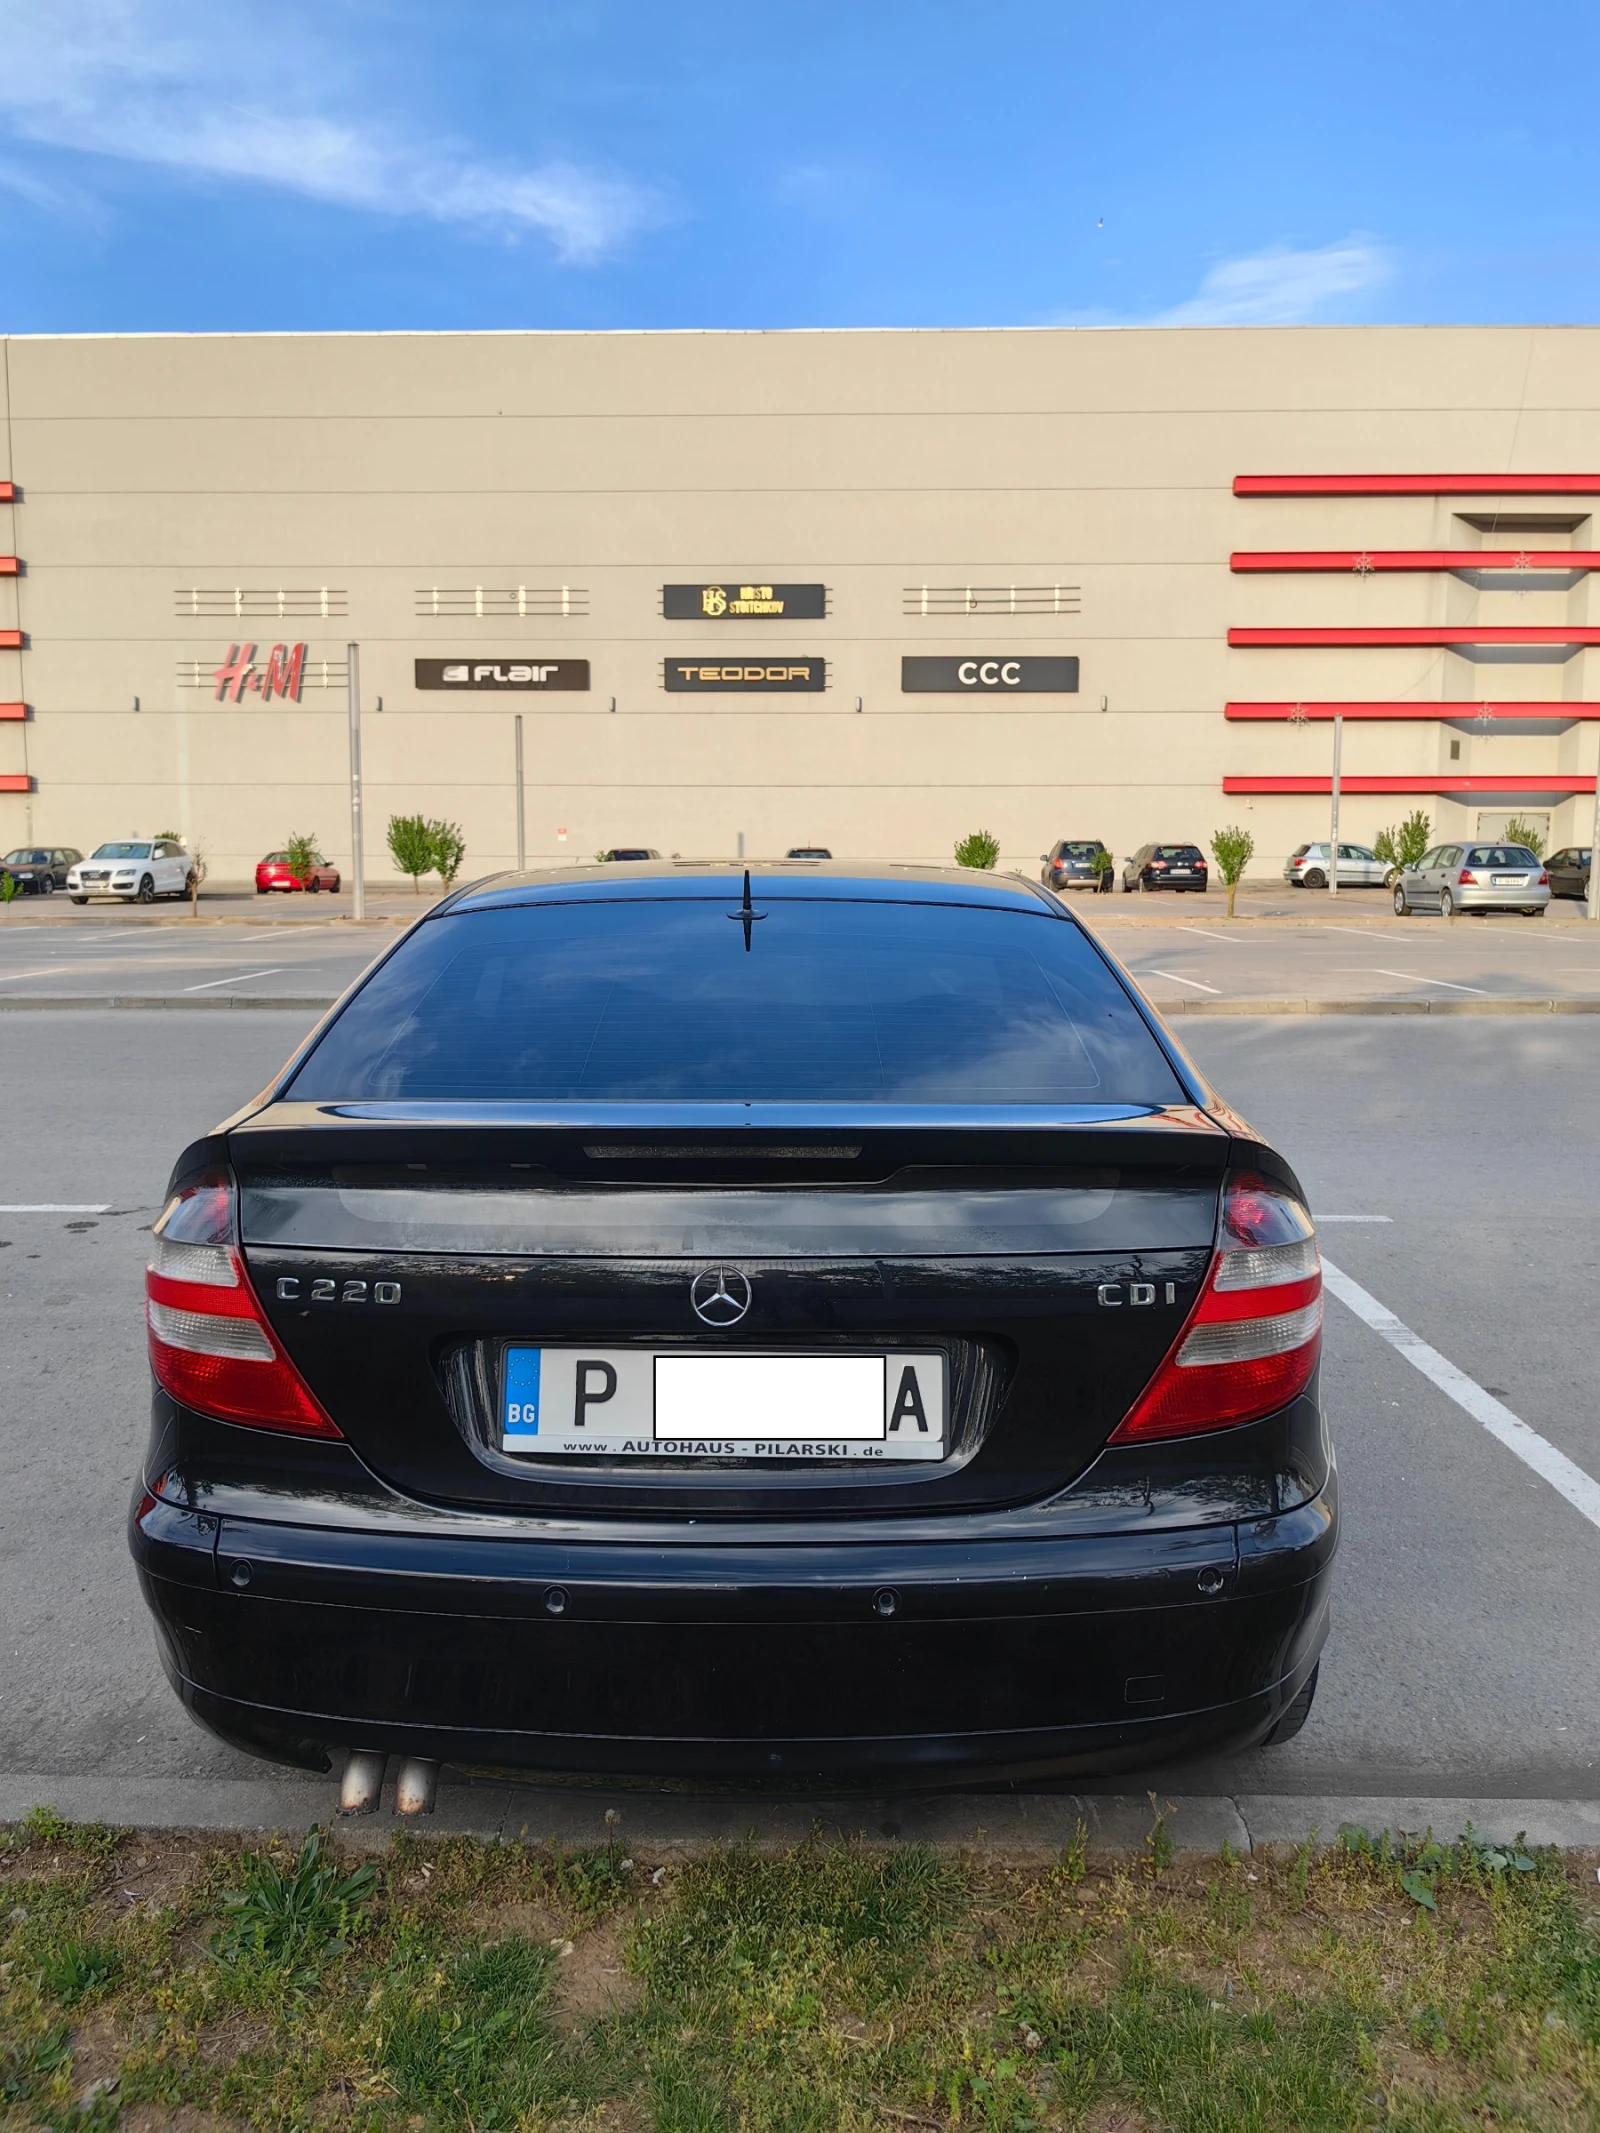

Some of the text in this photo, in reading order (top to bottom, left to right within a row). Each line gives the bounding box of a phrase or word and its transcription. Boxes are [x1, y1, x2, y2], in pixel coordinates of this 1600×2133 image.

[212, 642, 305, 703] H&M
[677, 667, 811, 681] TEODOR
[958, 661, 1021, 685] CCC
[276, 1277, 402, 1305] C 220
[1098, 1282, 1176, 1307] CDI
[574, 1360, 617, 1427] P
[507, 1403, 535, 1424] BG
